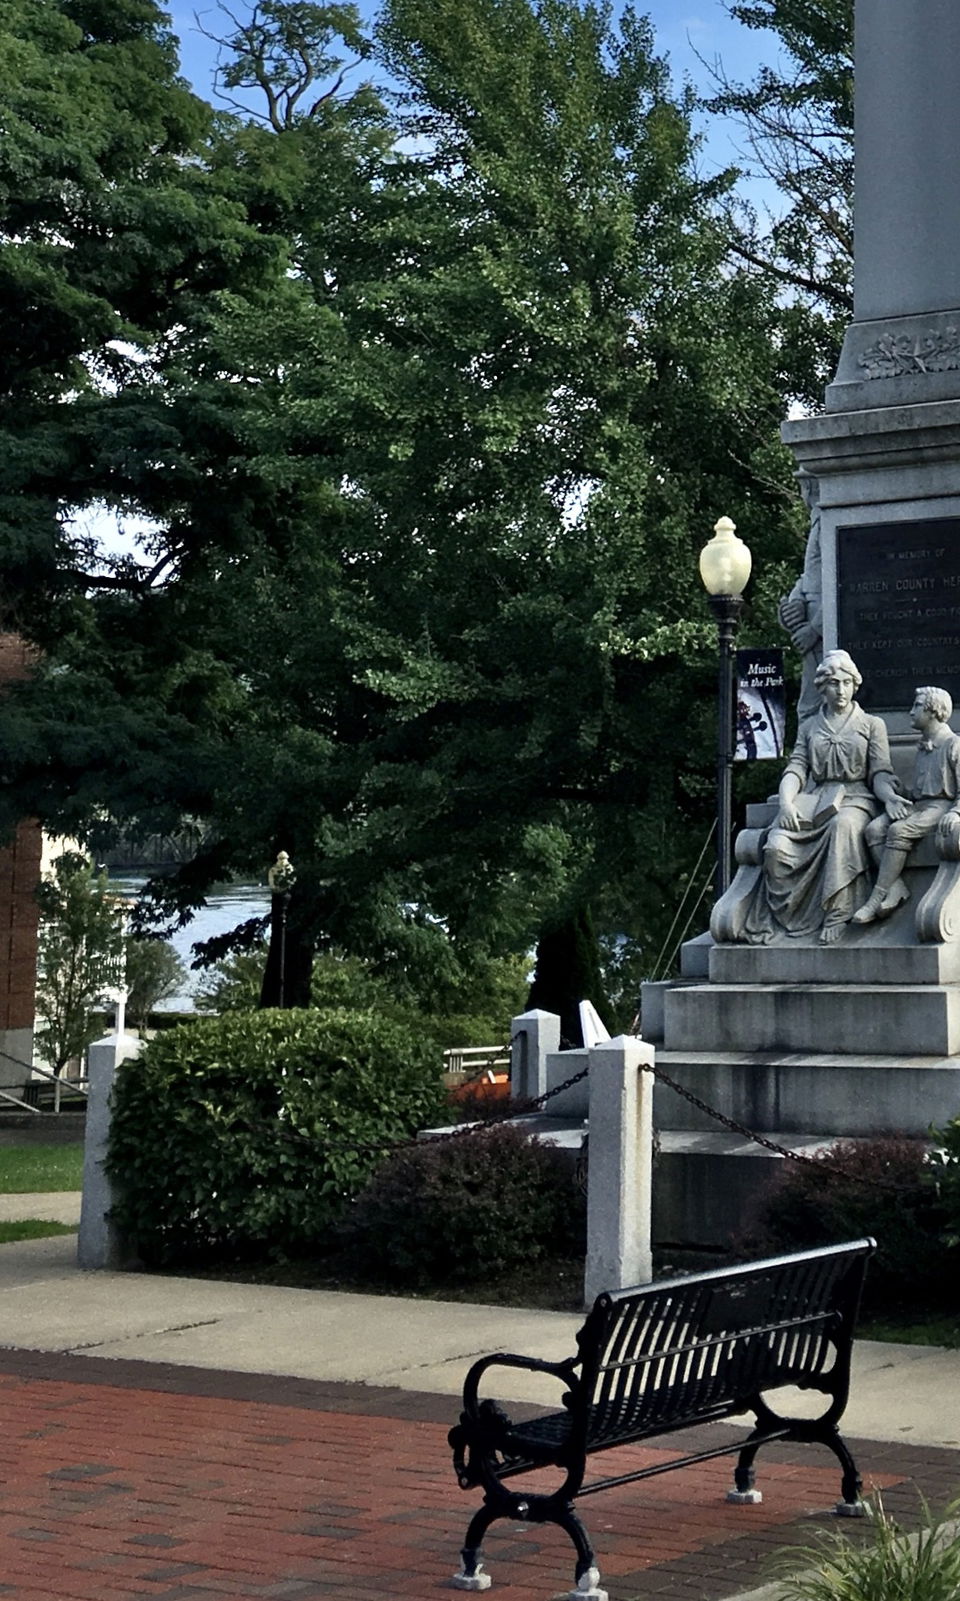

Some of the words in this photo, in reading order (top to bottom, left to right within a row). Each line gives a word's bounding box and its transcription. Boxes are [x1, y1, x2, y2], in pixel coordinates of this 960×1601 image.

[898, 550, 930, 560] MEMORY
[935, 548, 946, 558] OF
[849, 580, 888, 593] WARREN
[895, 577, 935, 591] COUNTY
[747, 663, 777, 675] Music
[740, 678, 749, 687] in
[750, 677, 764, 687] the
[764, 677, 784, 688] Park
